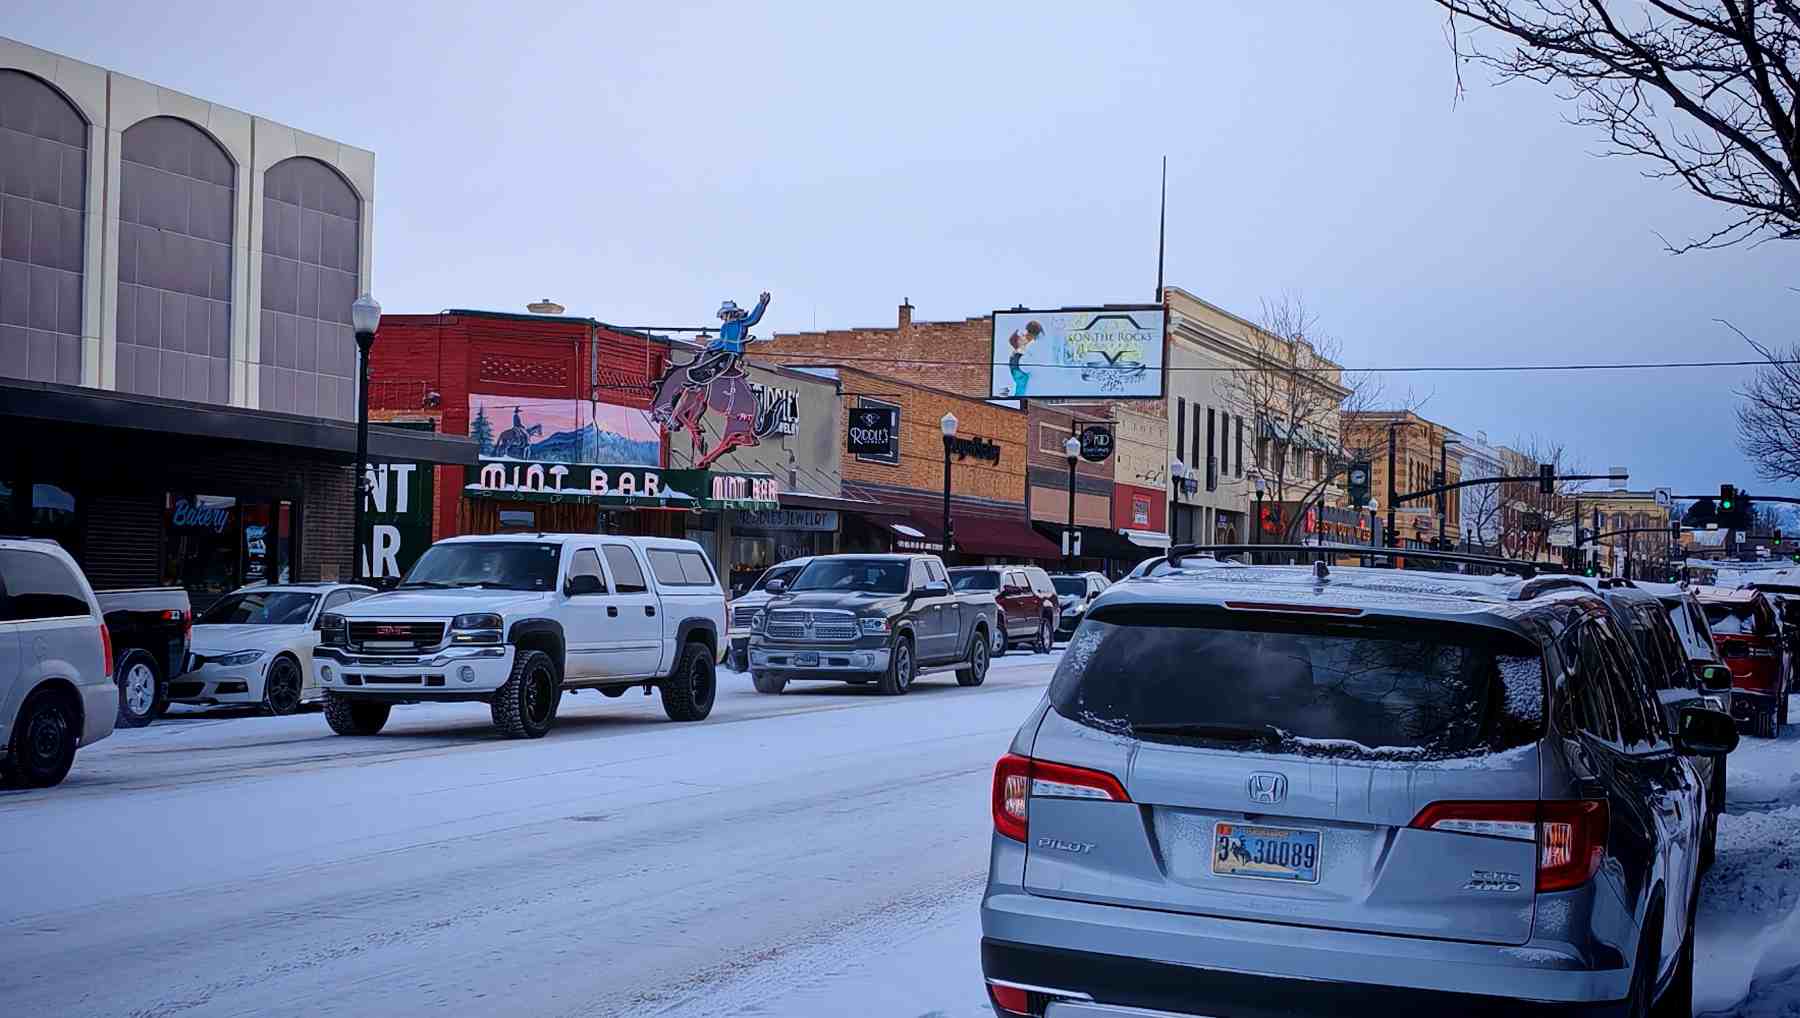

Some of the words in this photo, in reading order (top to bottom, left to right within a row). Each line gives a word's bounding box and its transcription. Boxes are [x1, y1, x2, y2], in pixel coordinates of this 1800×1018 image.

[480, 463, 569, 492] MINT
[590, 468, 659, 496] BAR
[712, 476, 745, 500] MINT
[752, 478, 778, 502] BAR
[173, 498, 229, 533] Bakery
[1038, 838, 1096, 854] PILOT
[1218, 836, 1229, 861] 3
[1254, 839, 1315, 868] 30089
[1463, 880, 1520, 892] AWD
